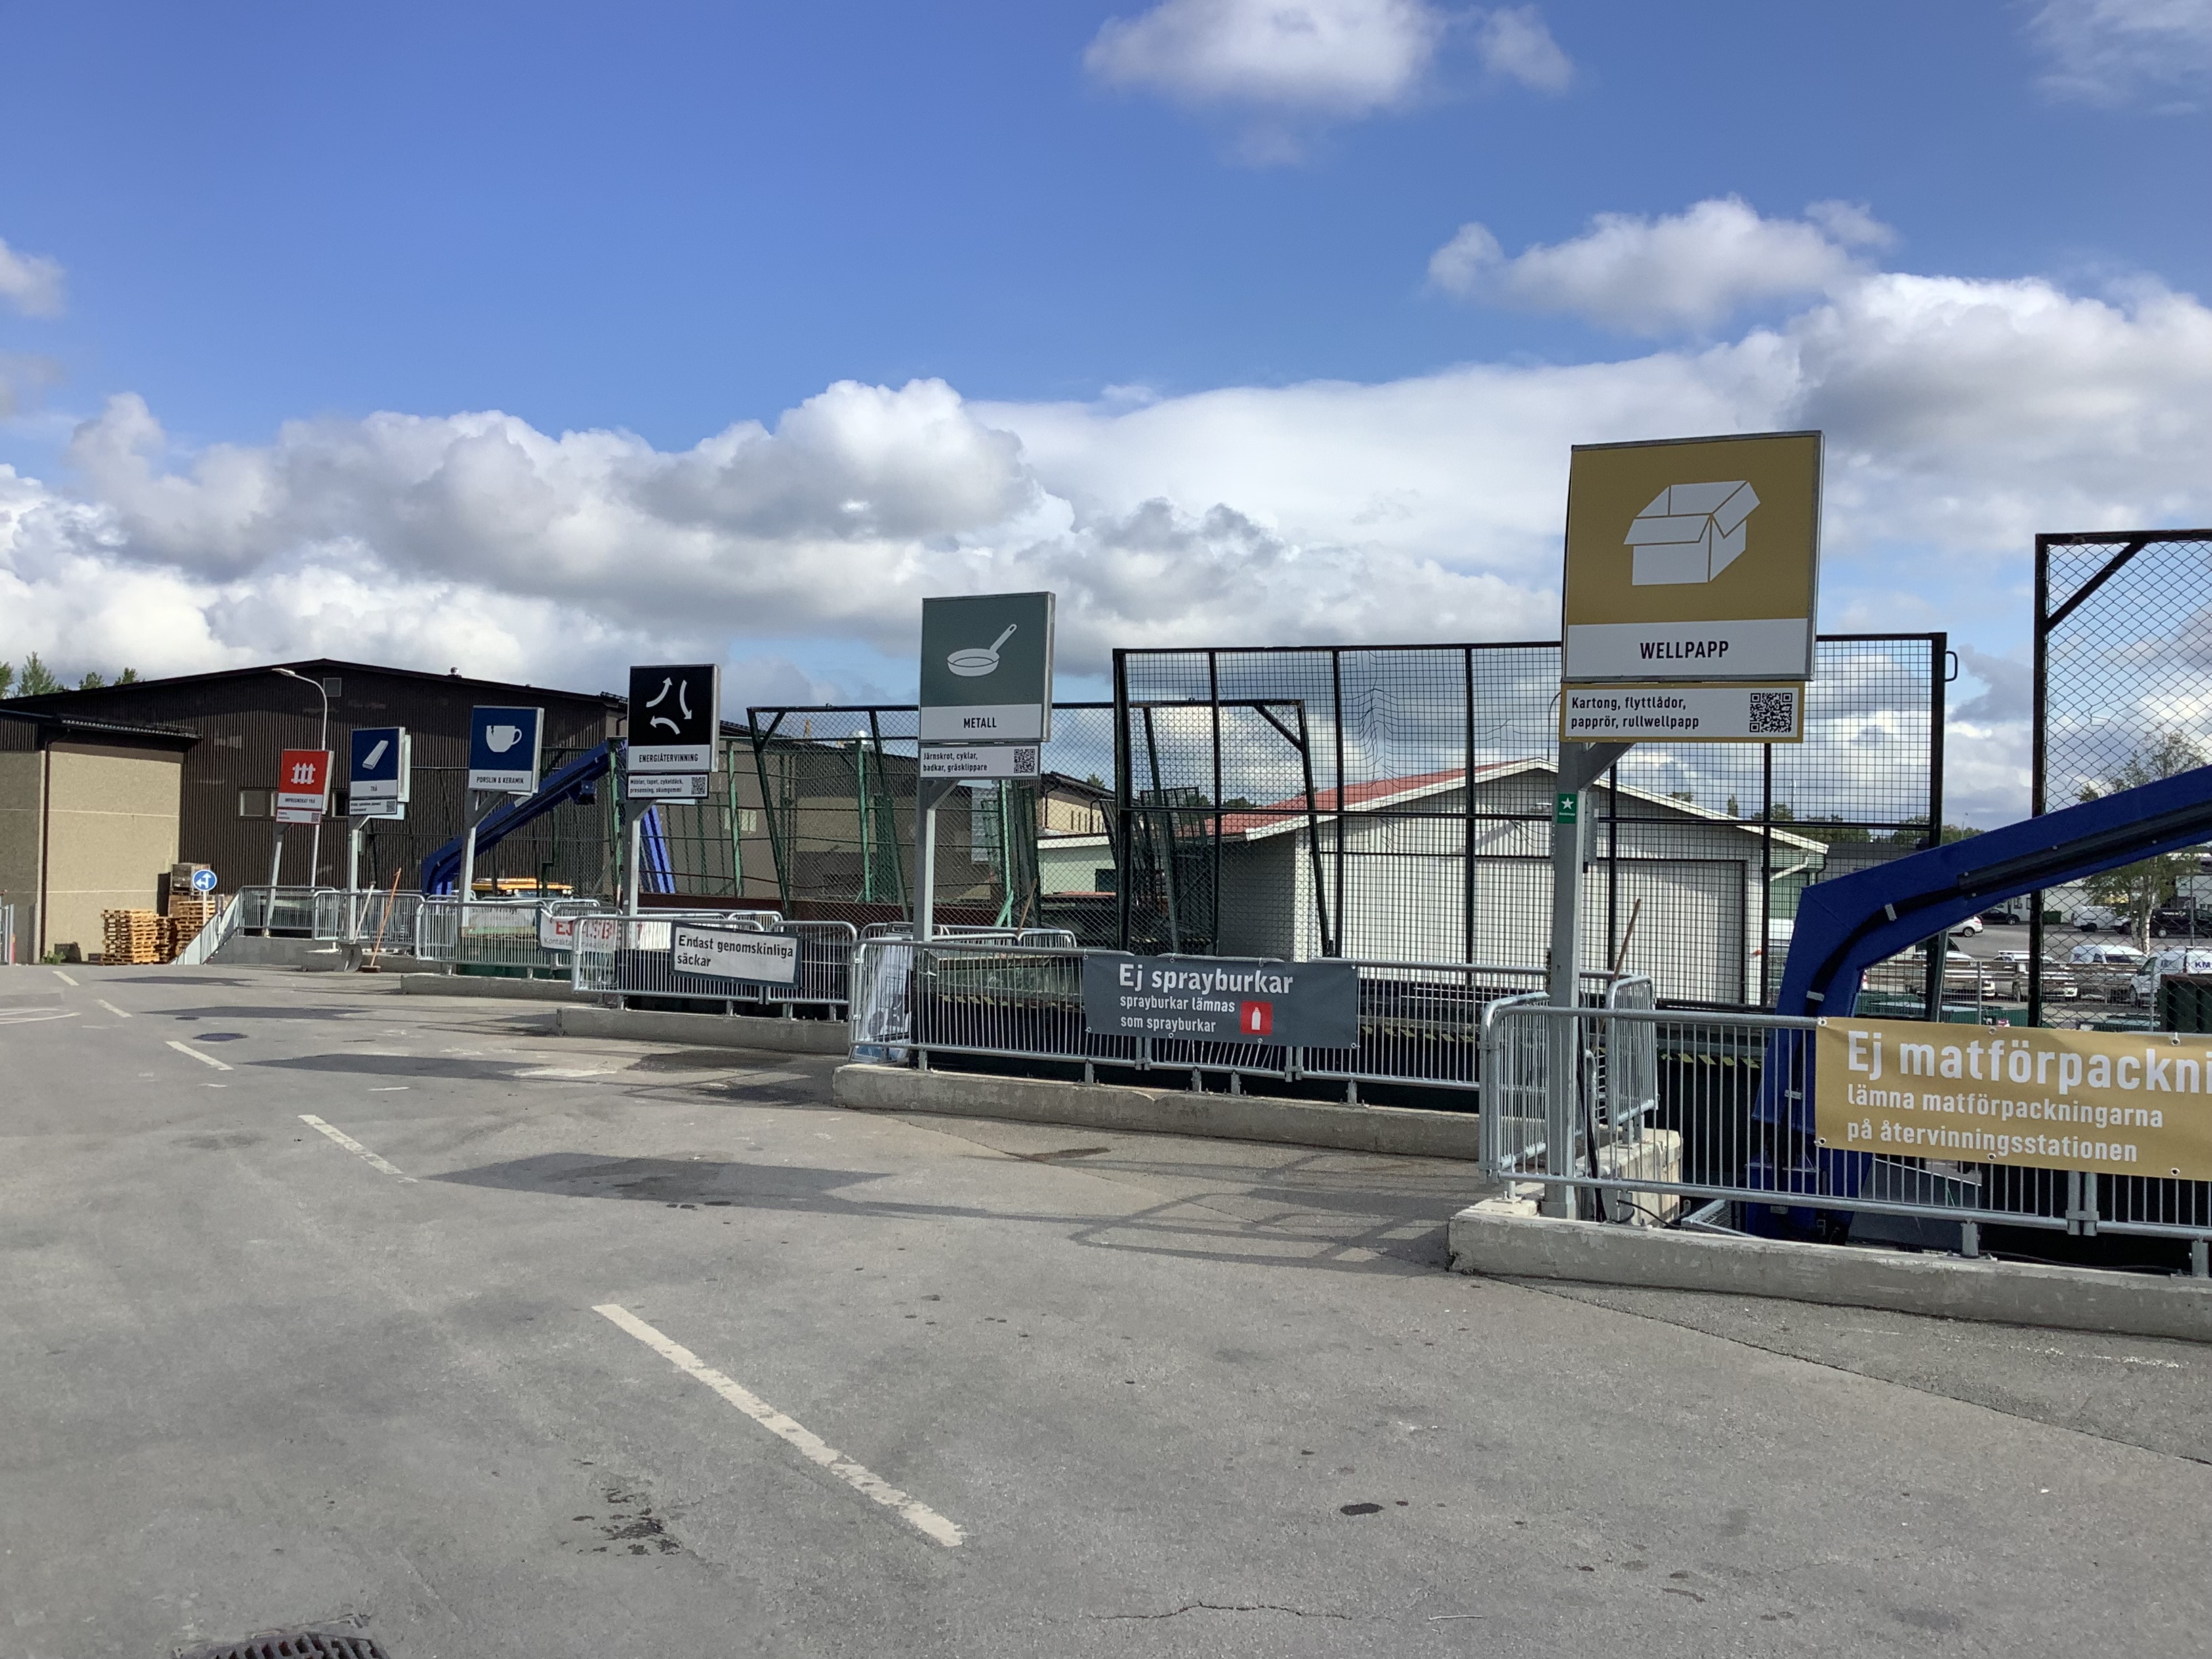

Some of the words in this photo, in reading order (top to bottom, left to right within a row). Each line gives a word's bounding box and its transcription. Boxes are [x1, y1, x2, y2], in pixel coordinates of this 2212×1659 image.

[1640, 640, 1729, 659] WELLPAPP
[1572, 696, 1620, 711] Kartong,
[1624, 695, 1686, 710] flyttlådor,
[963, 717, 997, 729] METALL
[1571, 716, 1618, 730] papprör,
[1622, 716, 1699, 729] rullwellpapp
[639, 753, 699, 762] ENERGIÅTERVINNING
[923, 752, 955, 761] Järnskrot,
[956, 752, 978, 761] cyklar,
[923, 764, 946, 773] badkar,
[947, 763, 987, 773] gräsklippare
[678, 934, 714, 950] Endast
[717, 938, 794, 959] genomskinliga
[678, 951, 712, 968] säckar
[1120, 963, 1143, 991] Ej
[1151, 968, 1294, 995] sprayburkar
[1120, 995, 1191, 1011] sprayburkar
[1192, 997, 1235, 1013] lämnas
[1120, 1017, 1144, 1029] som
[1147, 1018, 1216, 1033] sprayburkar
[1847, 1030, 1882, 1081] Ej
[1847, 1084, 1914, 1110] lämna
[1922, 1092, 2164, 1129] matförpackningarna
[1847, 1118, 1872, 1142] på
[1880, 1120, 2137, 1162] återvinningsstationen
